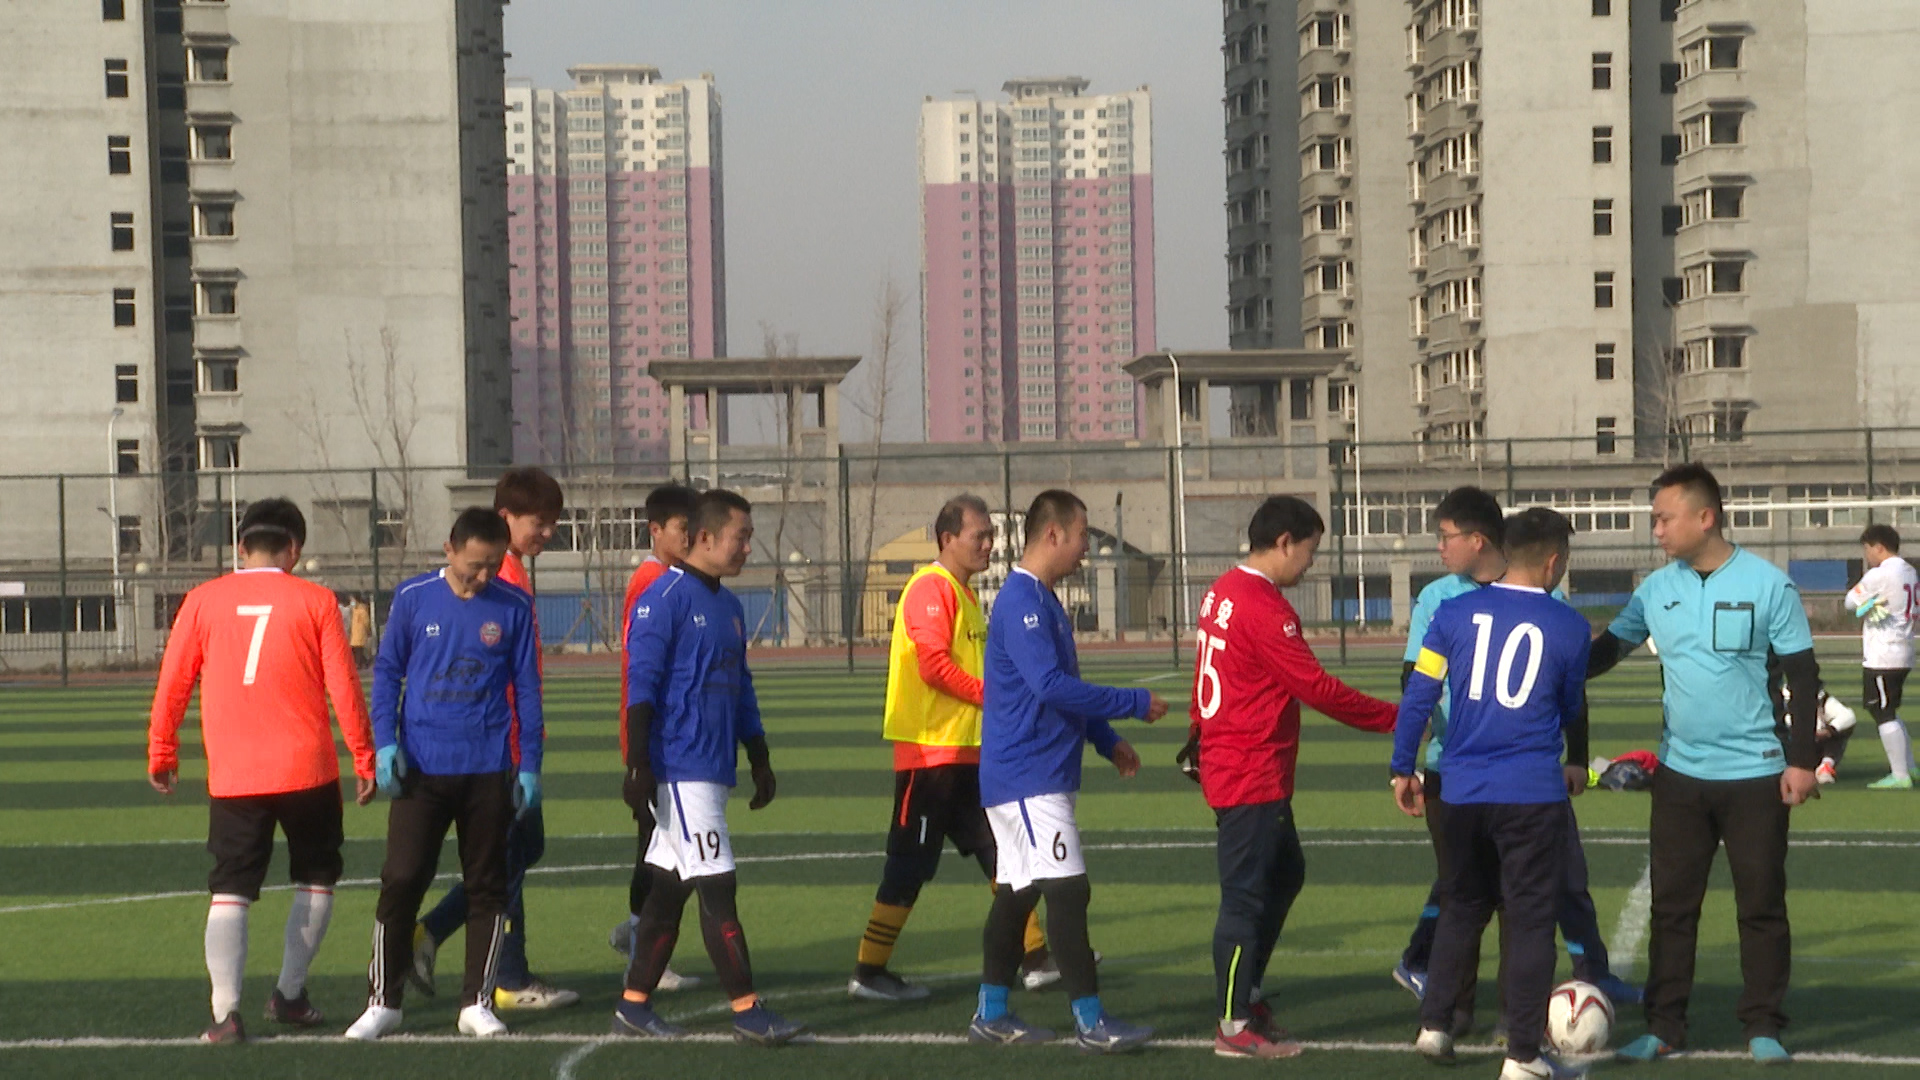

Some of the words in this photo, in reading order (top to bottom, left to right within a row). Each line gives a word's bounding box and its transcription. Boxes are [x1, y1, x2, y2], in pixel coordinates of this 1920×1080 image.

[236, 604, 273, 686] 7
[1468, 612, 1544, 709] 10
[693, 830, 720, 861] 19
[919, 815, 928, 845] 1
[1053, 831, 1067, 861] 6
